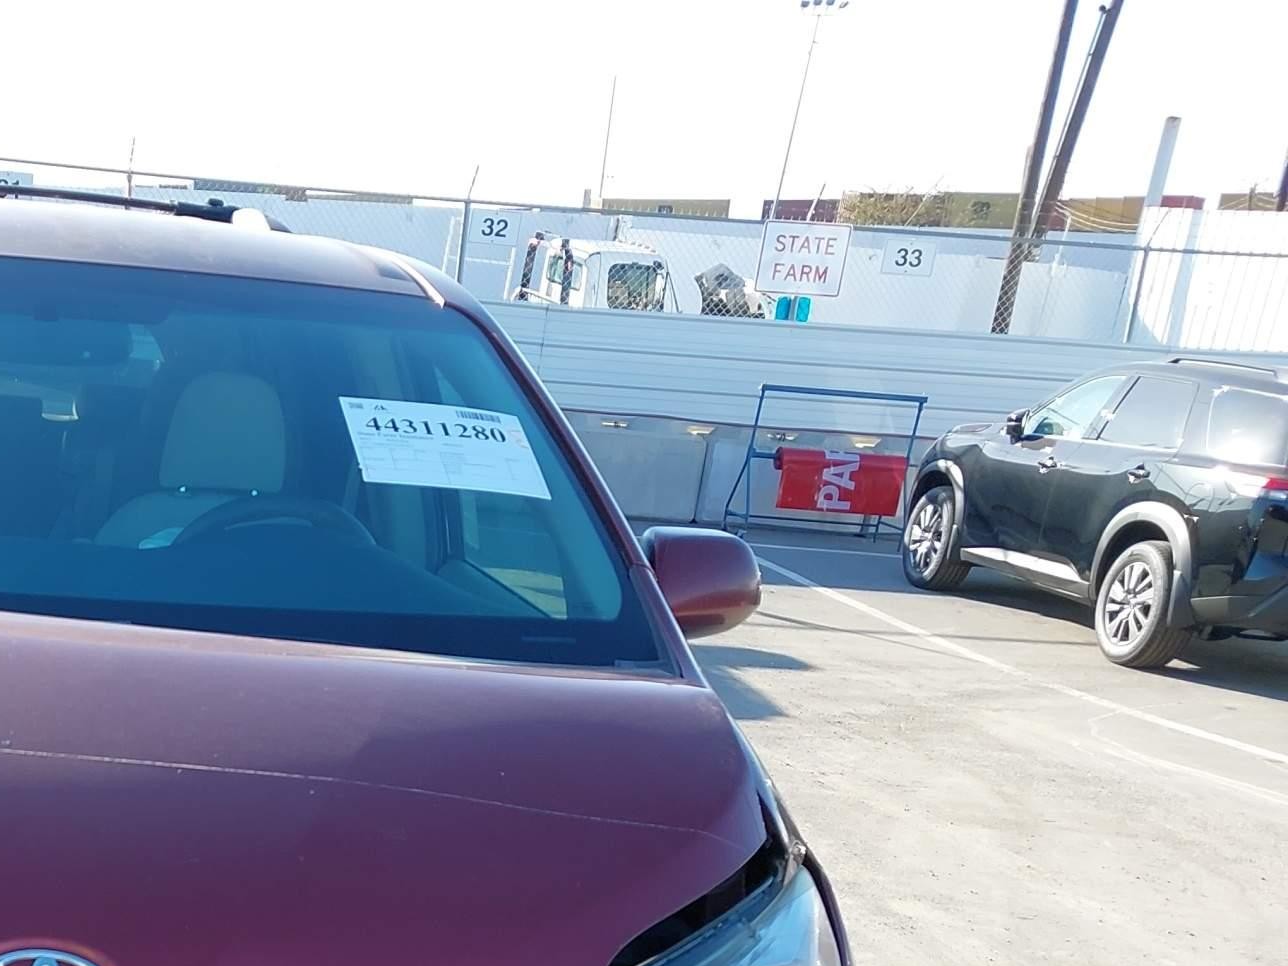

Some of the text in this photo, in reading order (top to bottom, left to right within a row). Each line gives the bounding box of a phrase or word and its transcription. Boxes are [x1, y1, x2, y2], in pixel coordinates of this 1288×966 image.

[481, 217, 509, 238] 32
[774, 234, 837, 256] STATE
[894, 247, 923, 268] 33
[772, 262, 829, 285] FARM
[365, 416, 507, 443] 44311280
